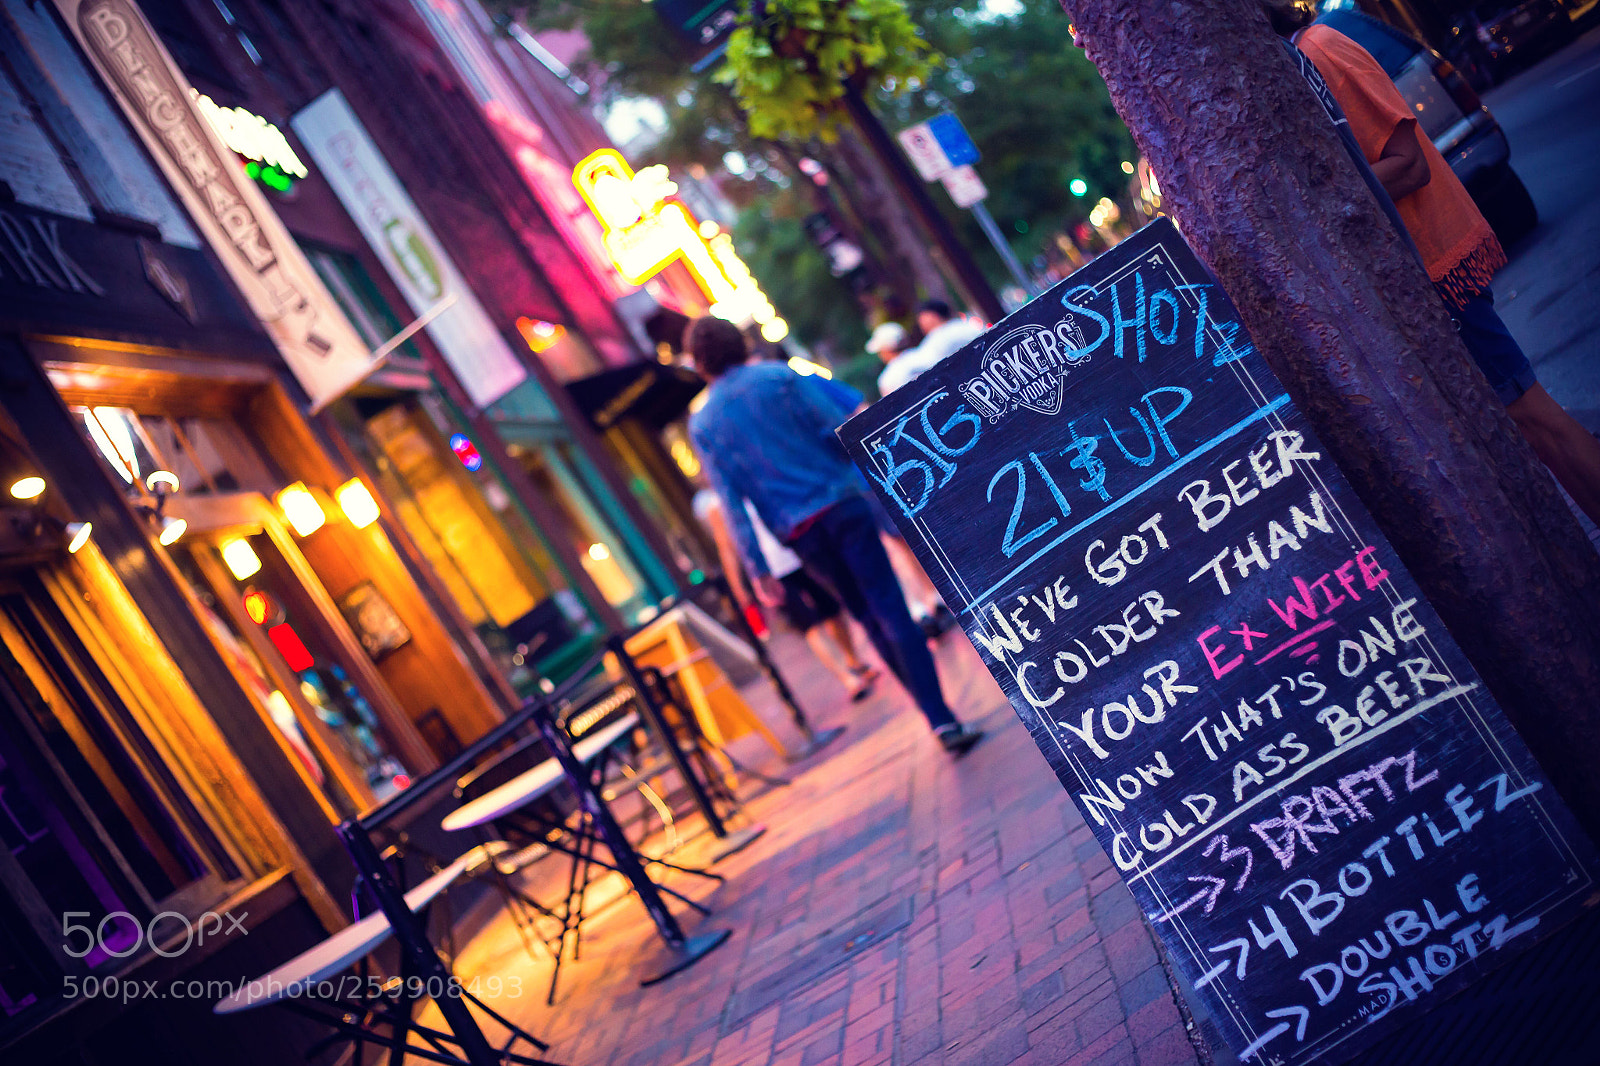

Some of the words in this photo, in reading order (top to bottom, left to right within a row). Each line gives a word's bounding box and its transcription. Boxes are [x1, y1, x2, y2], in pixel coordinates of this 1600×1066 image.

[89, 8, 277, 274] BENCHMARK
[969, 322, 1083, 416] PICKERS
[1018, 372, 1059, 405] VODKA
[1102, 386, 1193, 468] UP
[866, 391, 983, 519] BIG
[973, 575, 1079, 661] WE'VE
[1084, 512, 1170, 587] GOT
[1177, 429, 1321, 533] BEER
[1016, 589, 1182, 709] COLDER
[1187, 490, 1335, 596] THAN
[1058, 659, 1200, 760] YOUR
[1266, 544, 1391, 631] WIFE
[1078, 750, 1176, 827] NOW
[1180, 671, 1328, 762] THAT'S
[1337, 597, 1427, 678] ONE
[1111, 792, 1218, 872] COLD
[1231, 731, 1311, 804] ASS
[1315, 656, 1453, 748] BEER
[1249, 747, 1441, 872] DRAFTZ
[1247, 904, 1299, 959] 4
[1278, 772, 1544, 937] BOTTLEZ
[1299, 872, 1491, 1007] DOUBLE
[1357, 912, 1542, 1024] SHOTZ
